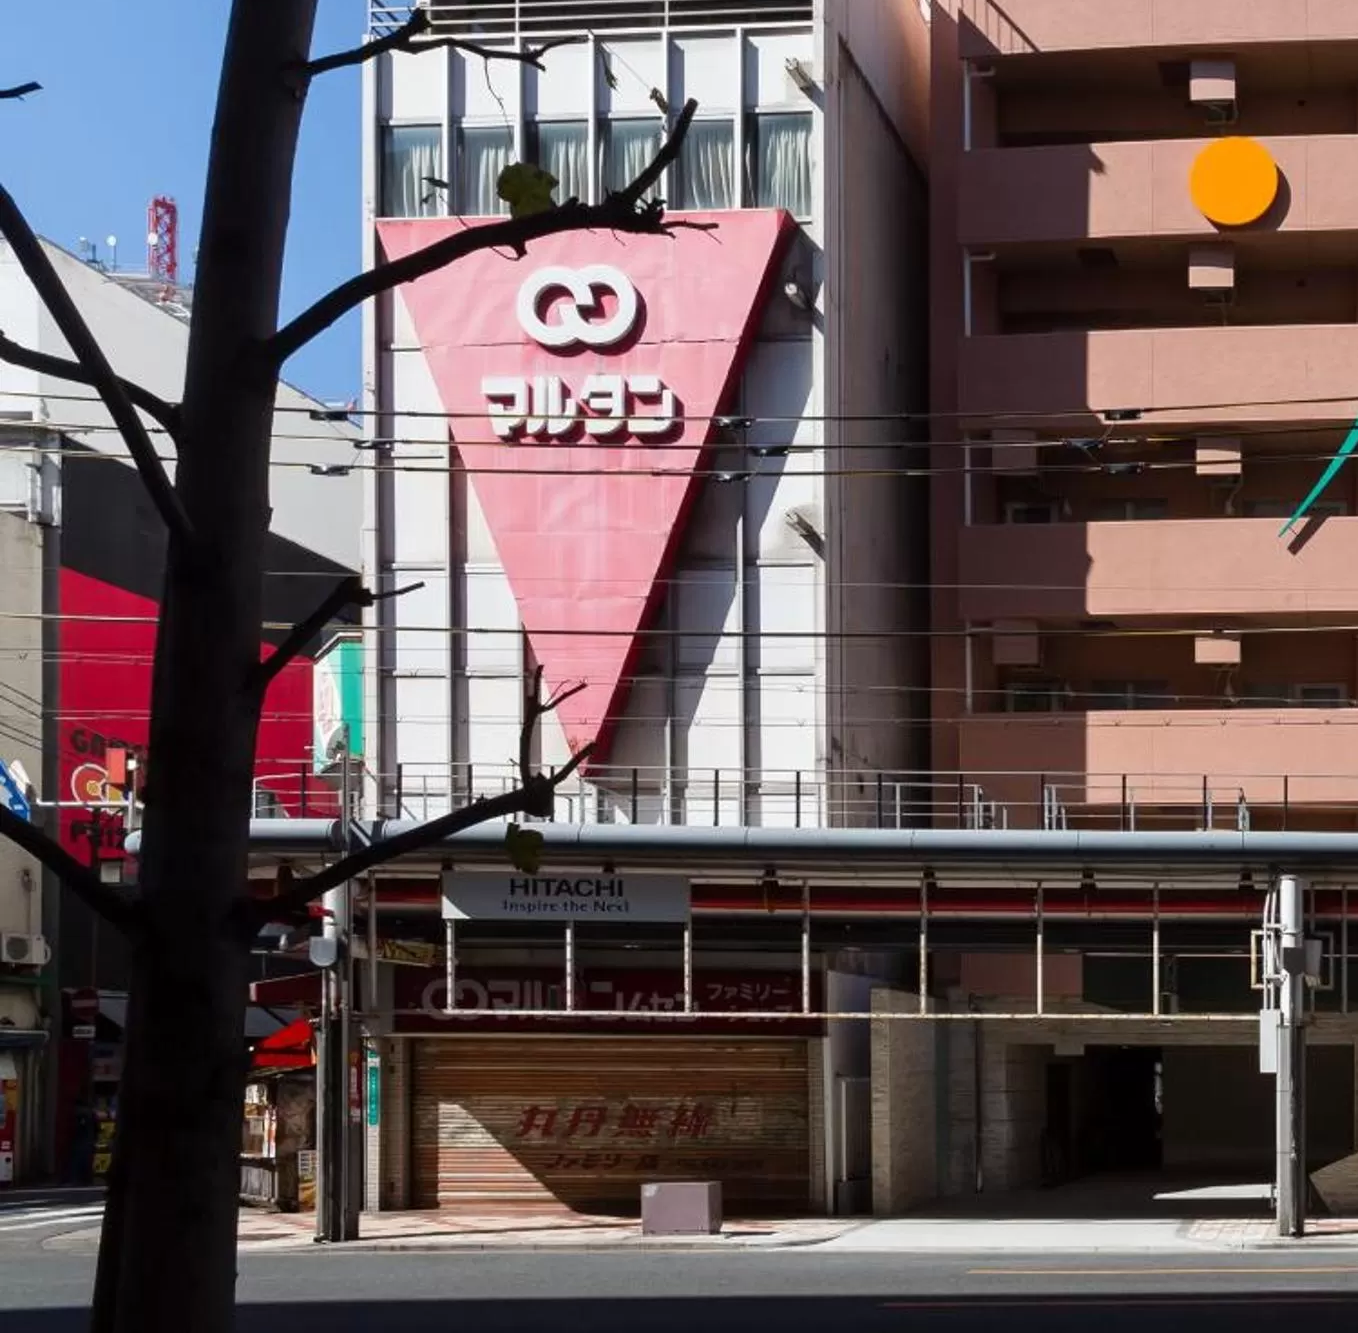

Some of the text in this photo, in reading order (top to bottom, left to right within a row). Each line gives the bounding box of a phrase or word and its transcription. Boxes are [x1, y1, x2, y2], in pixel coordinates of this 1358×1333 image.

[482, 374, 677, 437] マルタン
[510, 878, 625, 897] HITACHI
[503, 900, 630, 914] Inspire the Next
[705, 982, 792, 1002] ファミリー
